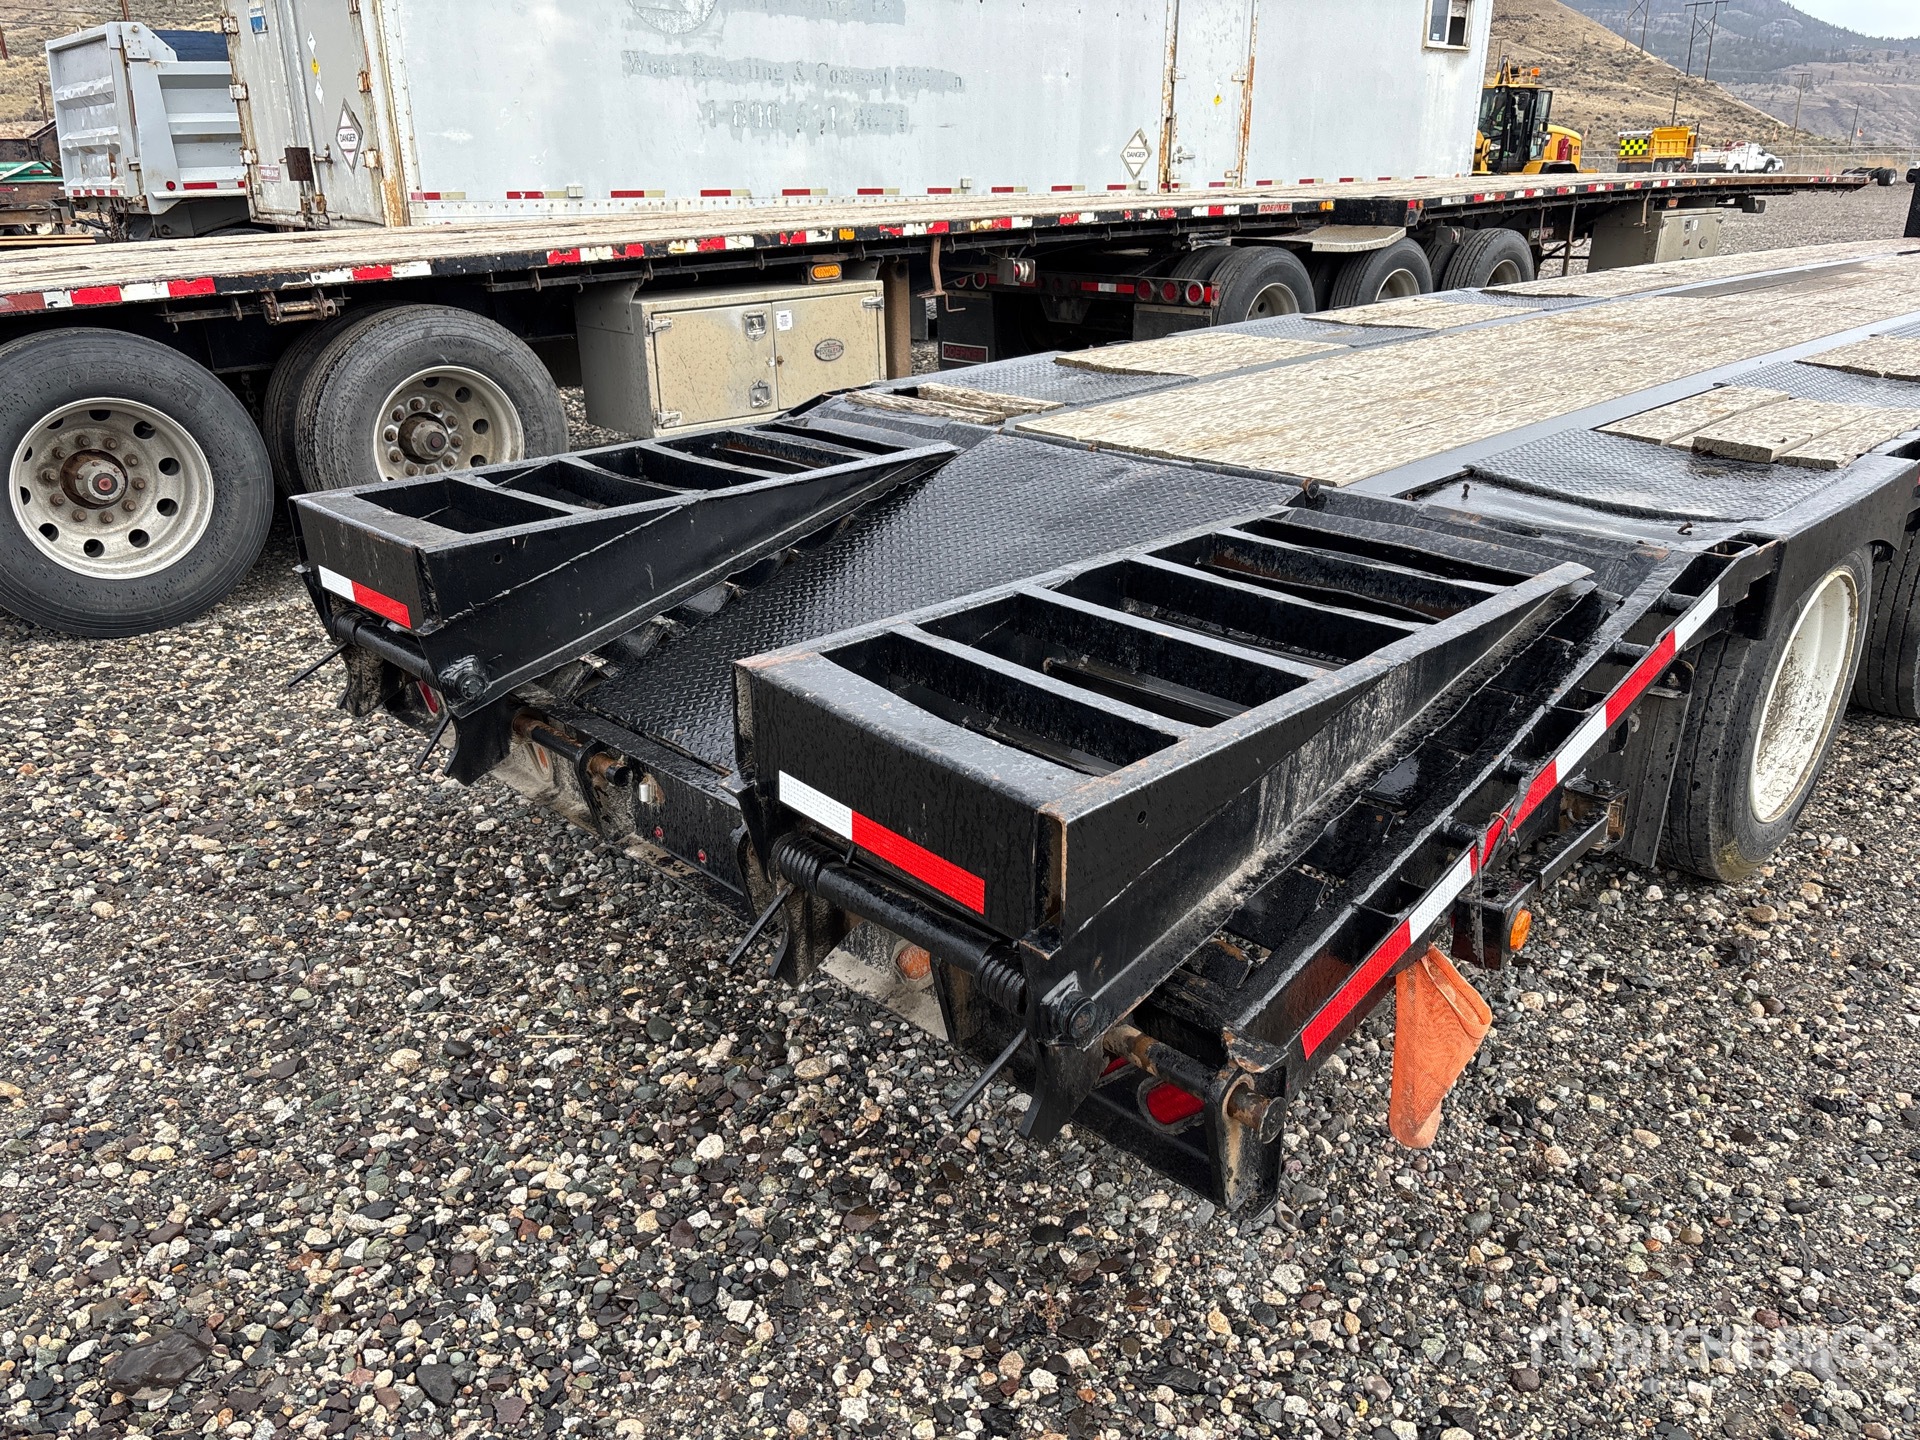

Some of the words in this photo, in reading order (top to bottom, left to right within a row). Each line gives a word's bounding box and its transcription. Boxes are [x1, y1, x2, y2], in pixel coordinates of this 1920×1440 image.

[339, 132, 357, 143] DANGER
[1126, 151, 1146, 159] DANGER
[1259, 203, 1291, 213] DOEPKER
